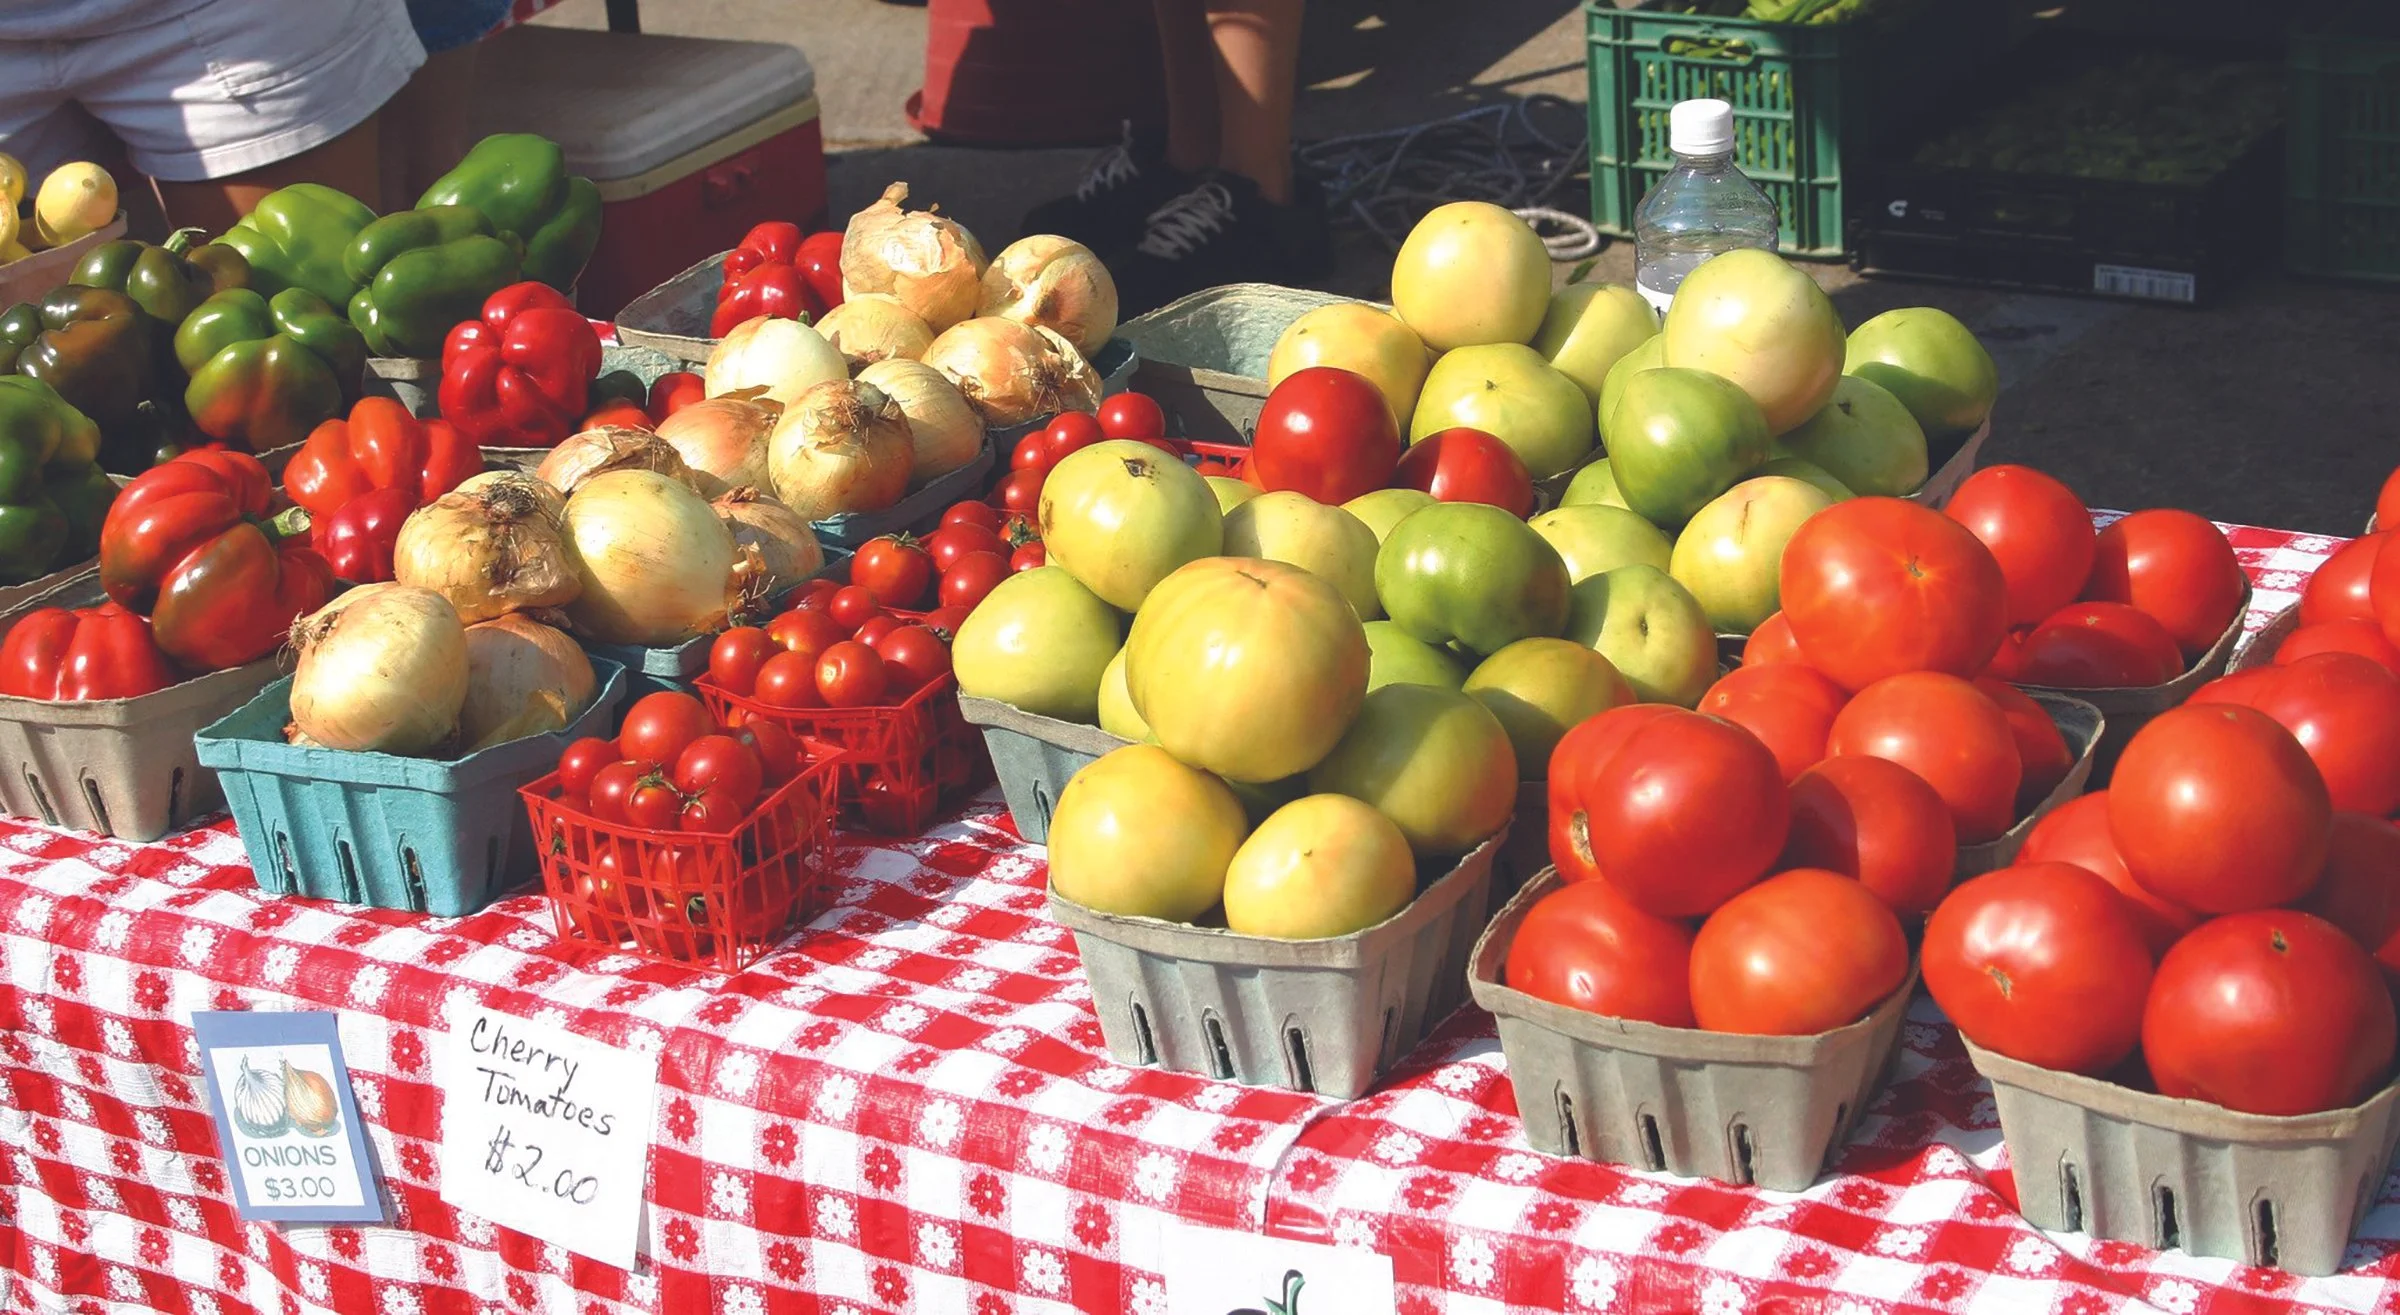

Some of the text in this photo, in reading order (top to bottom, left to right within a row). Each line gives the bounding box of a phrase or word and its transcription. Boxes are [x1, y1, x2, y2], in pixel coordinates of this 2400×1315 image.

[470, 1016, 578, 1094] Cherry
[476, 1066, 616, 1136] Tomatoes
[244, 1145, 337, 1167] ONIONS
[264, 1176, 336, 1202] $3.00
[484, 1124, 599, 1205] $2.00
